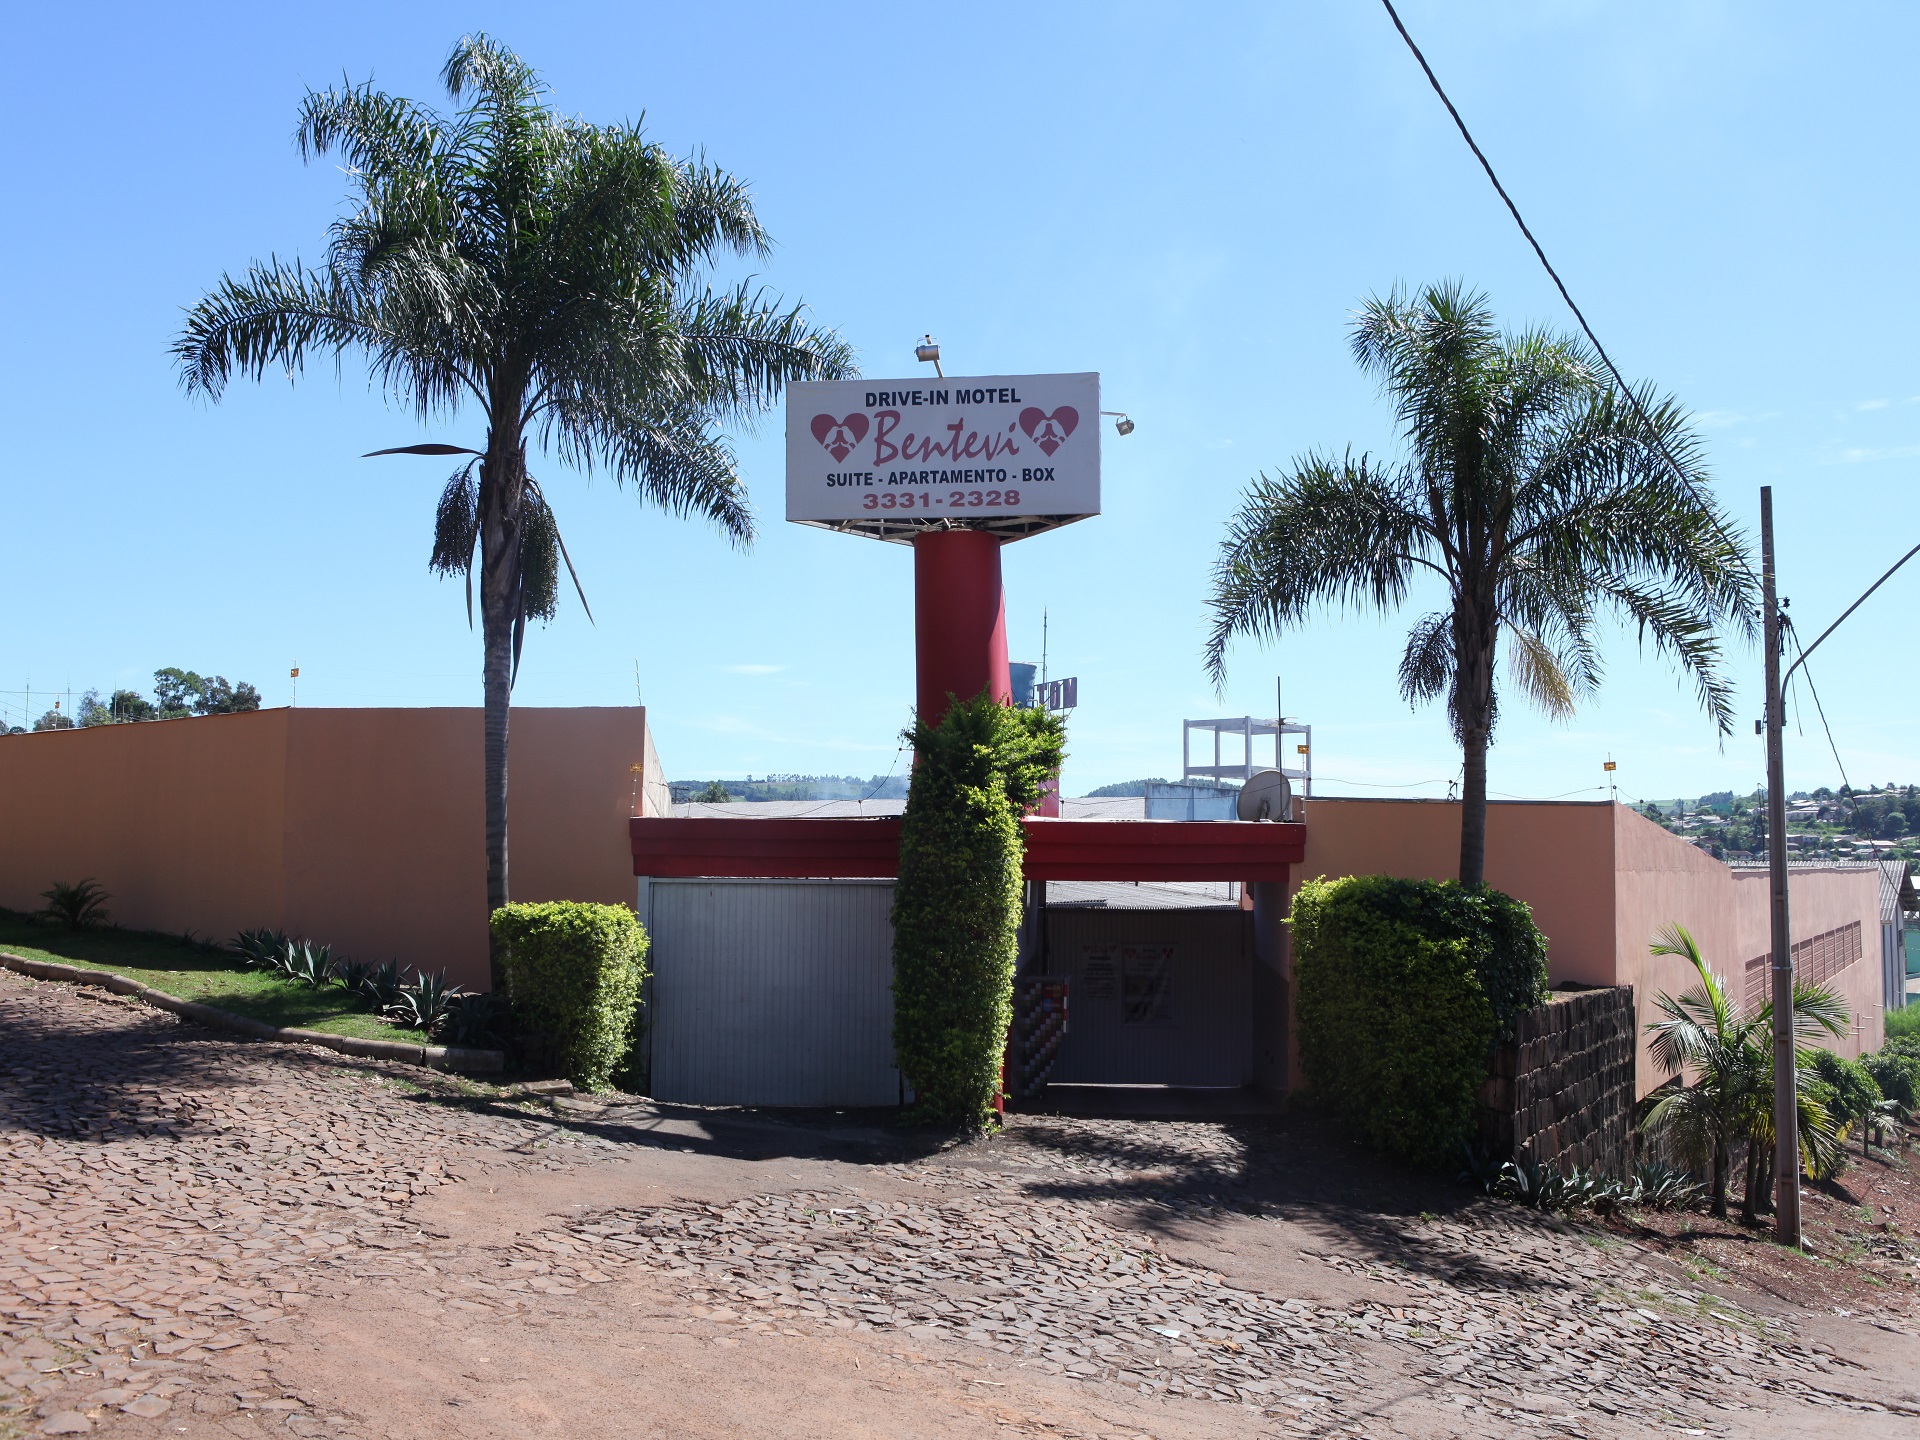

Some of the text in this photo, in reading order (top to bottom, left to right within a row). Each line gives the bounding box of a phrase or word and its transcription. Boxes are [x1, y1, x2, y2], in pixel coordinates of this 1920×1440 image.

[865, 388, 1022, 407] DRIVE-IN MOTEL
[873, 409, 1020, 467] Bentevi
[826, 472, 874, 487] SUITE
[887, 468, 1007, 486] APARTAMENTO
[1022, 467, 1055, 482] BOX
[862, 489, 1021, 510] 3331-2328
